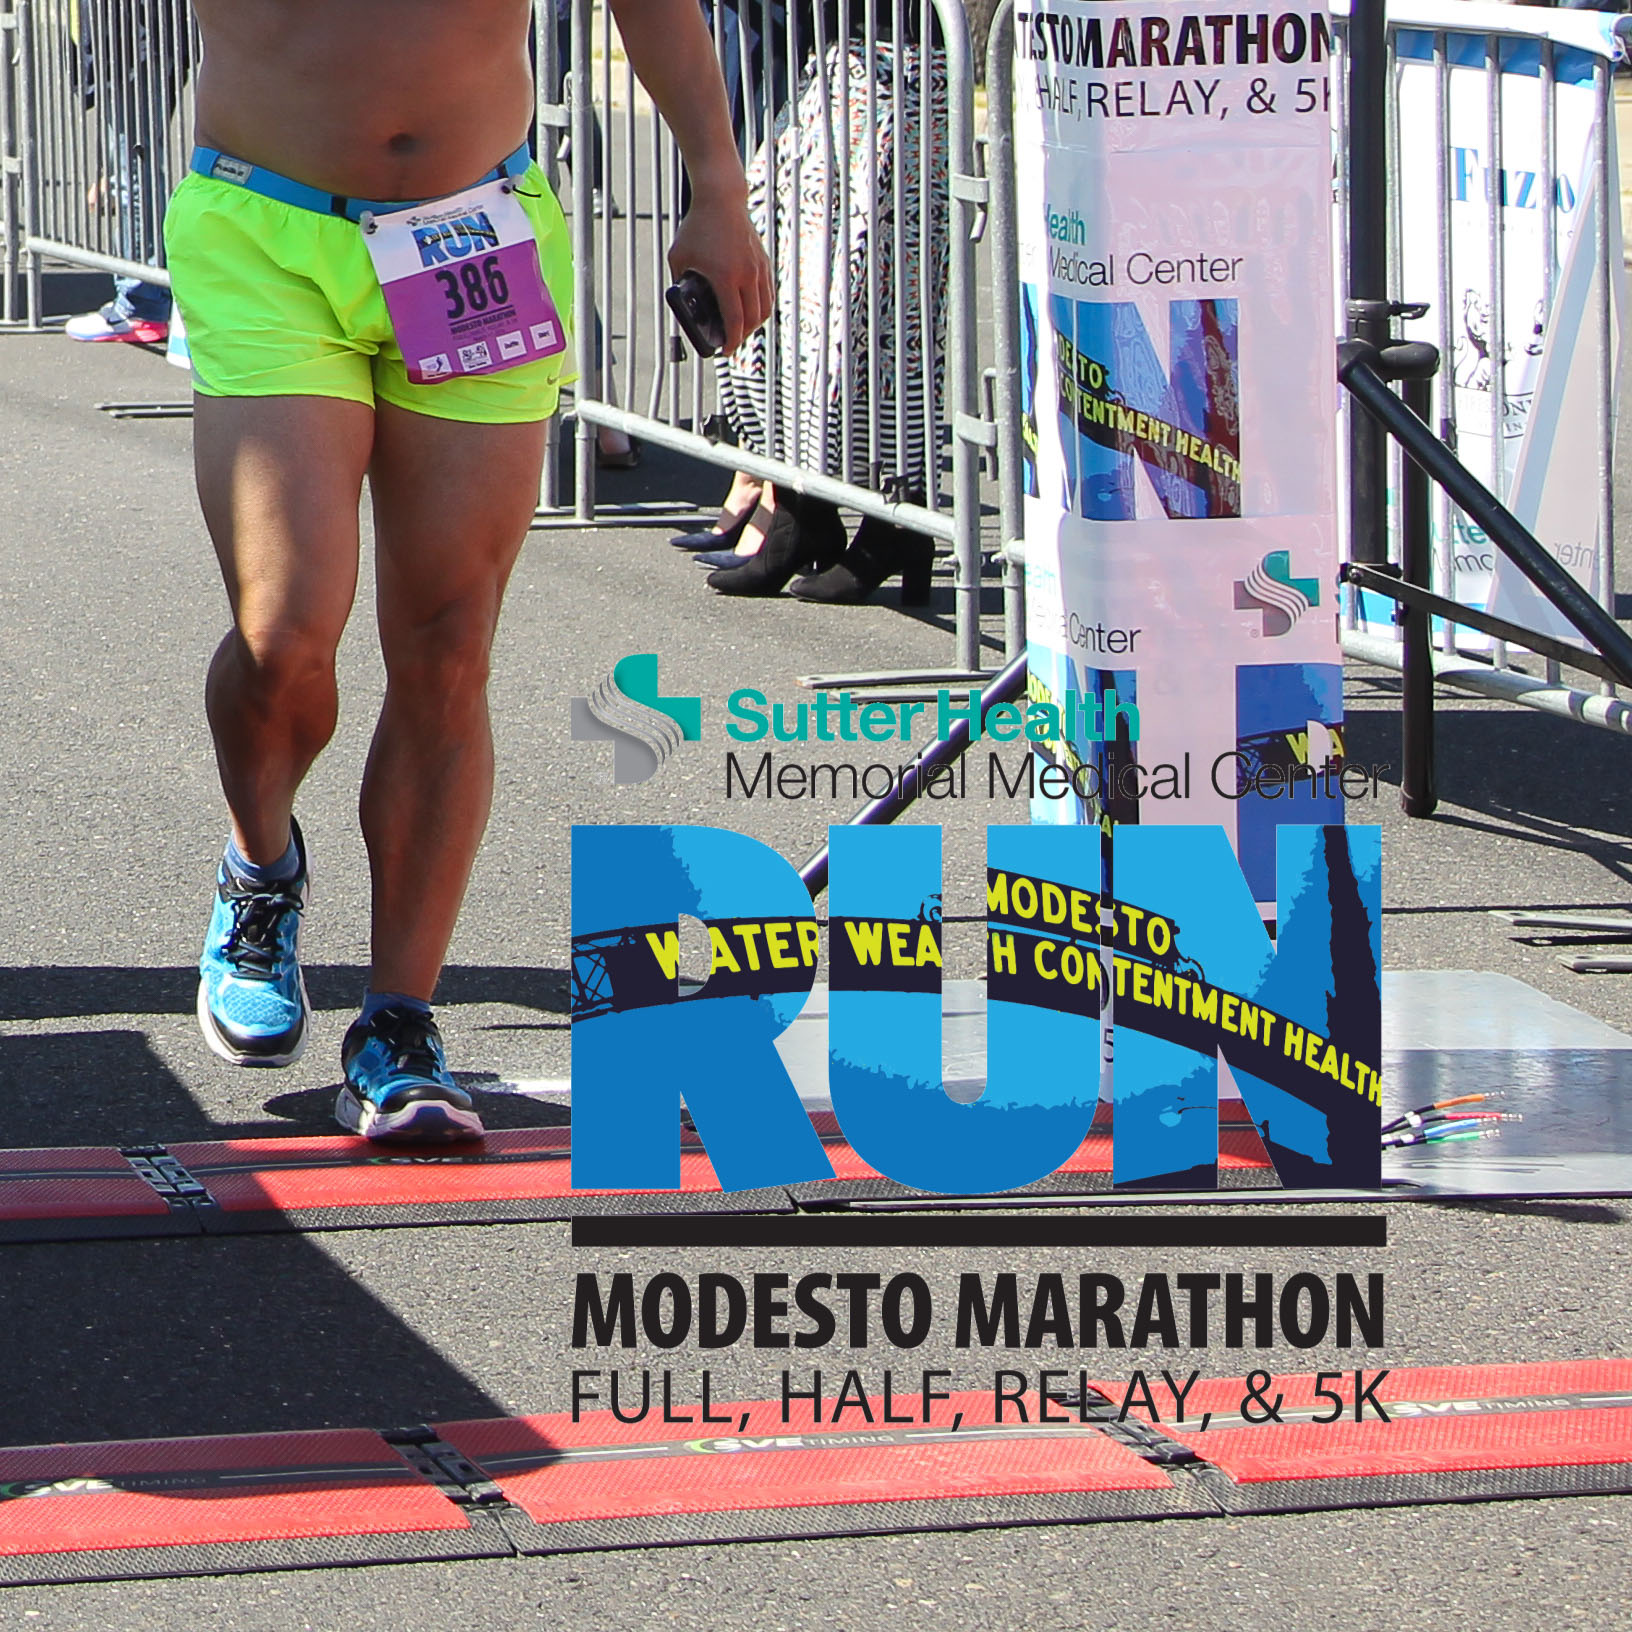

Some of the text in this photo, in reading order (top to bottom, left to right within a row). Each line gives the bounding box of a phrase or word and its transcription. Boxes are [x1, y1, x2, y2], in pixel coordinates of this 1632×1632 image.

[1076, 12, 1331, 69] MARATHON
[1087, 78, 1229, 120] RELAY,
[1246, 76, 1276, 115] &
[411, 211, 500, 268] RUN
[435, 255, 509, 319] 386
[1126, 251, 1244, 284] Center
[1069, 611, 1143, 654] Center
